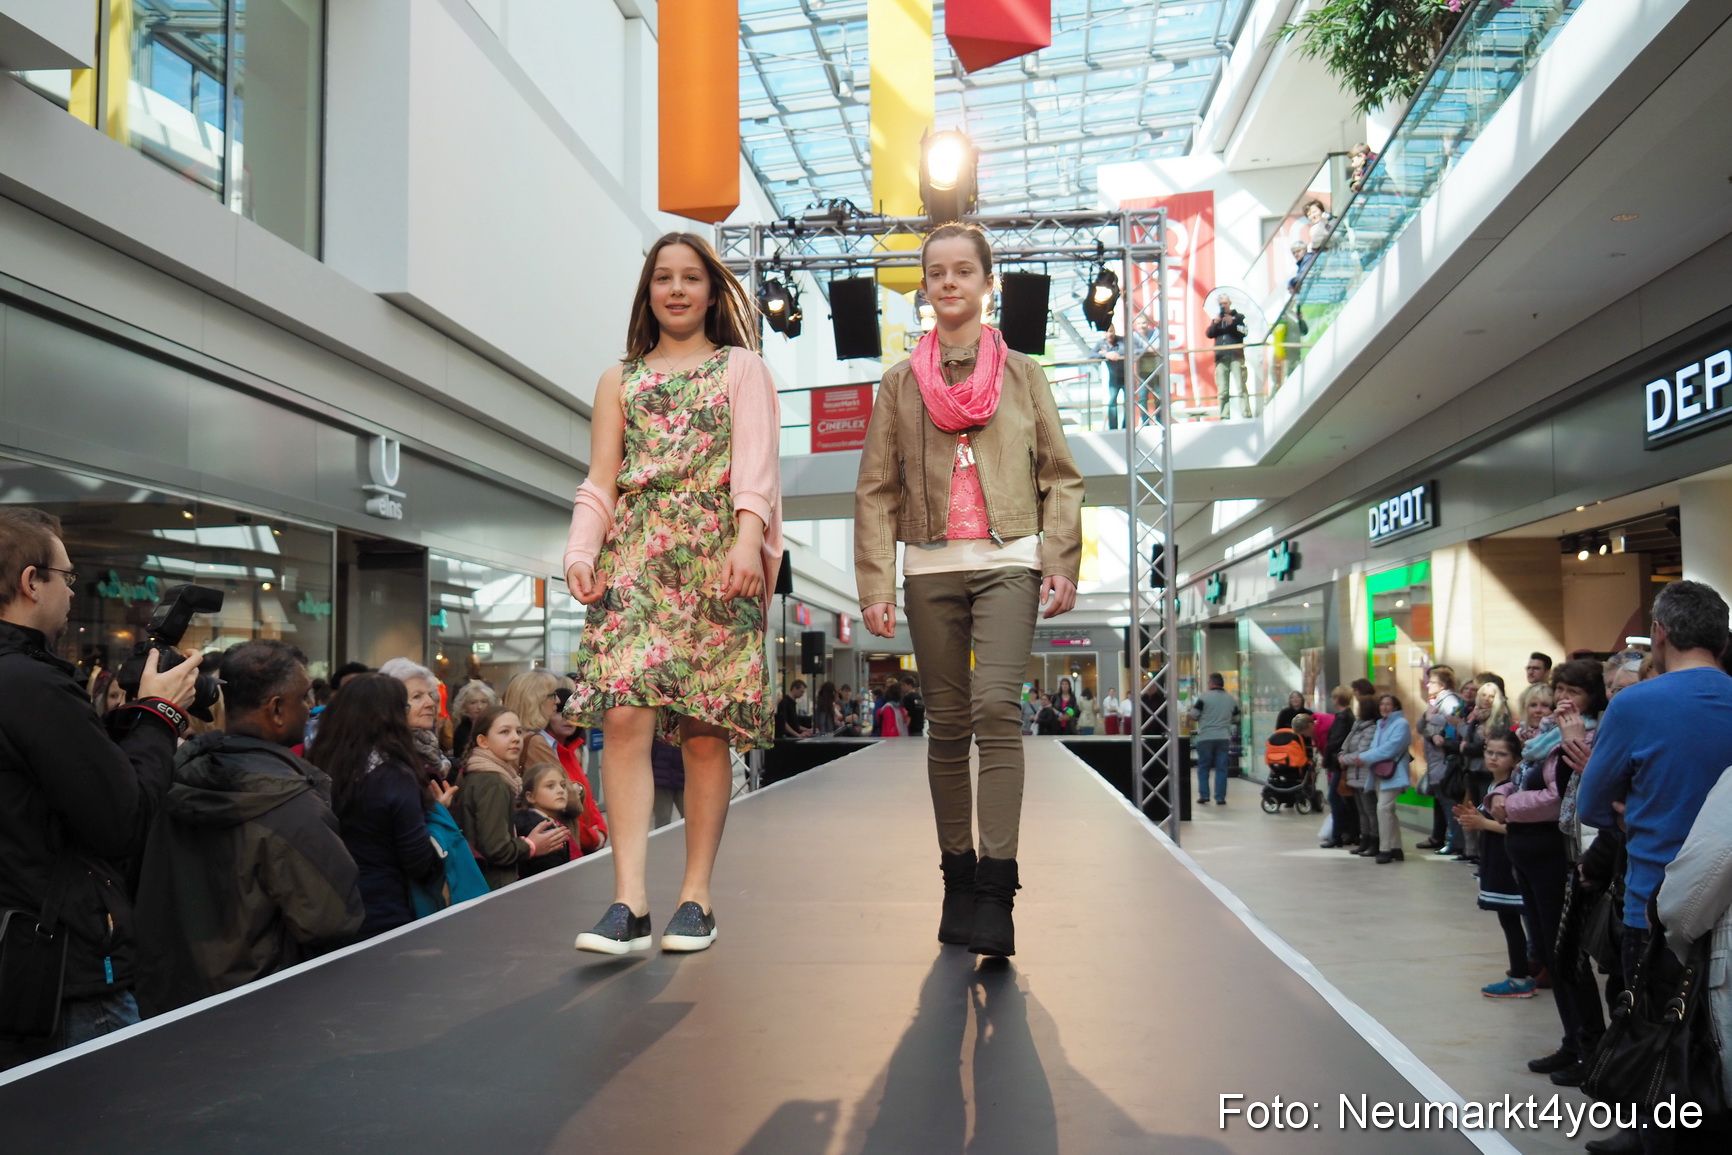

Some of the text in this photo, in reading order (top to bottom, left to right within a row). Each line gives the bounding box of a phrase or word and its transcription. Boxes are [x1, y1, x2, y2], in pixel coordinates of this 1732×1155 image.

[1645, 349, 1732, 433] DEP
[817, 419, 865, 433] CINEPLEX
[1368, 485, 1425, 538] DEPOT
[156, 702, 183, 724] EOS
